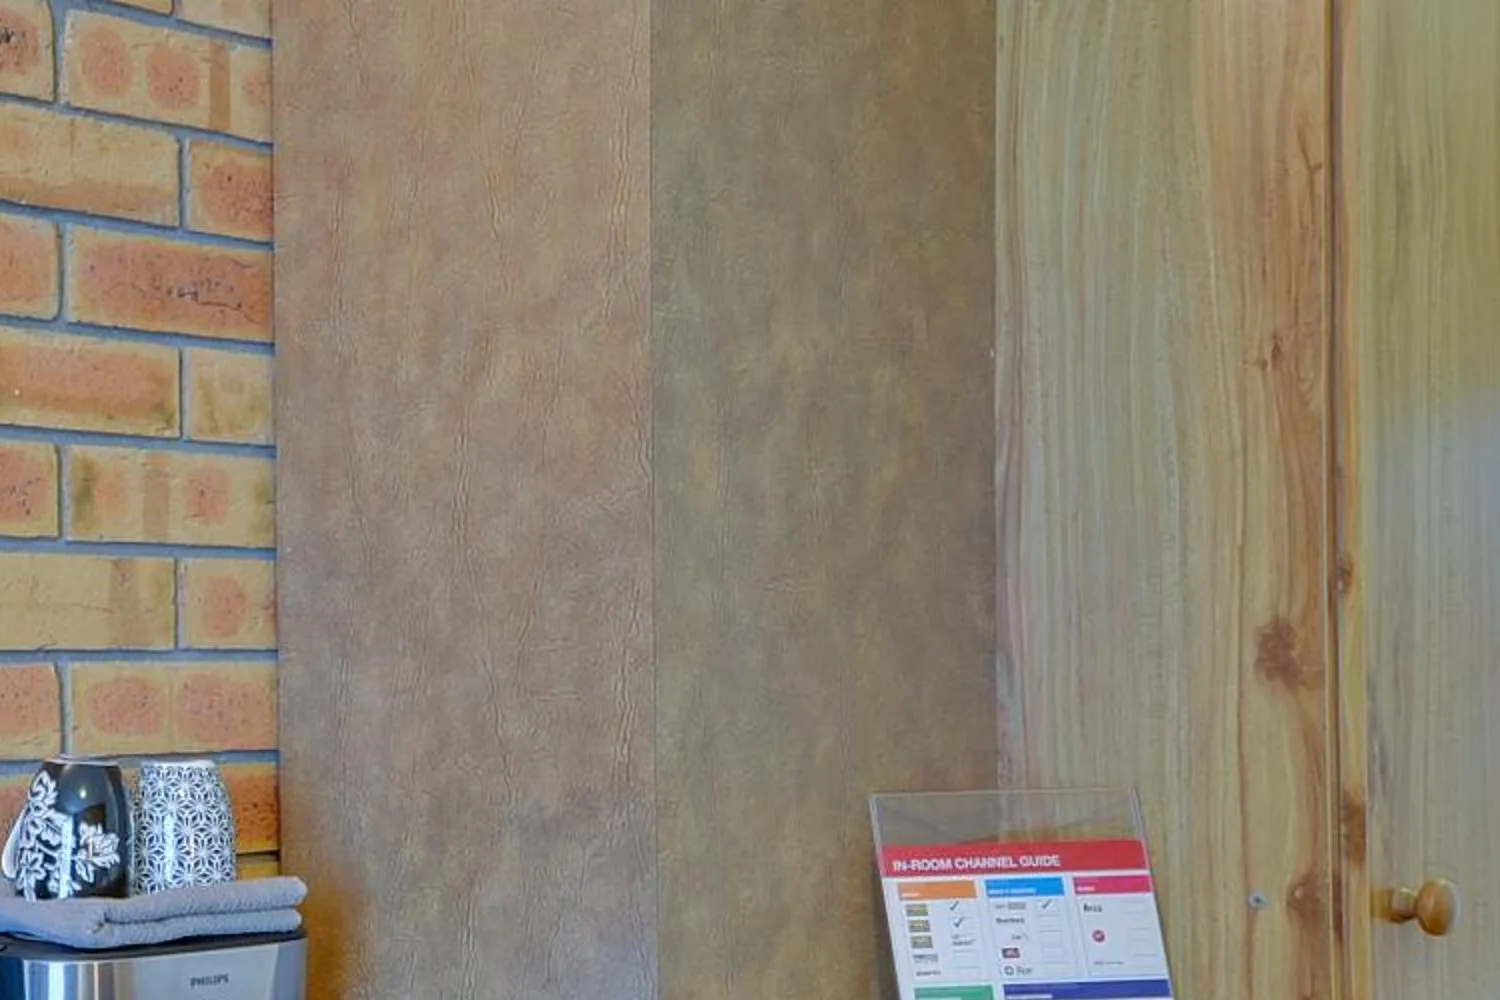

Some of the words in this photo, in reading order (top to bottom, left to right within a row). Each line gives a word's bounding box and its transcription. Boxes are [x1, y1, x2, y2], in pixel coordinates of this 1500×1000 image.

[892, 858, 952, 872] IN-ROOM
[955, 856, 1018, 870] CHANNEL
[1020, 855, 1061, 868] GUIDE
[190, 973, 229, 987] PHILIPS
